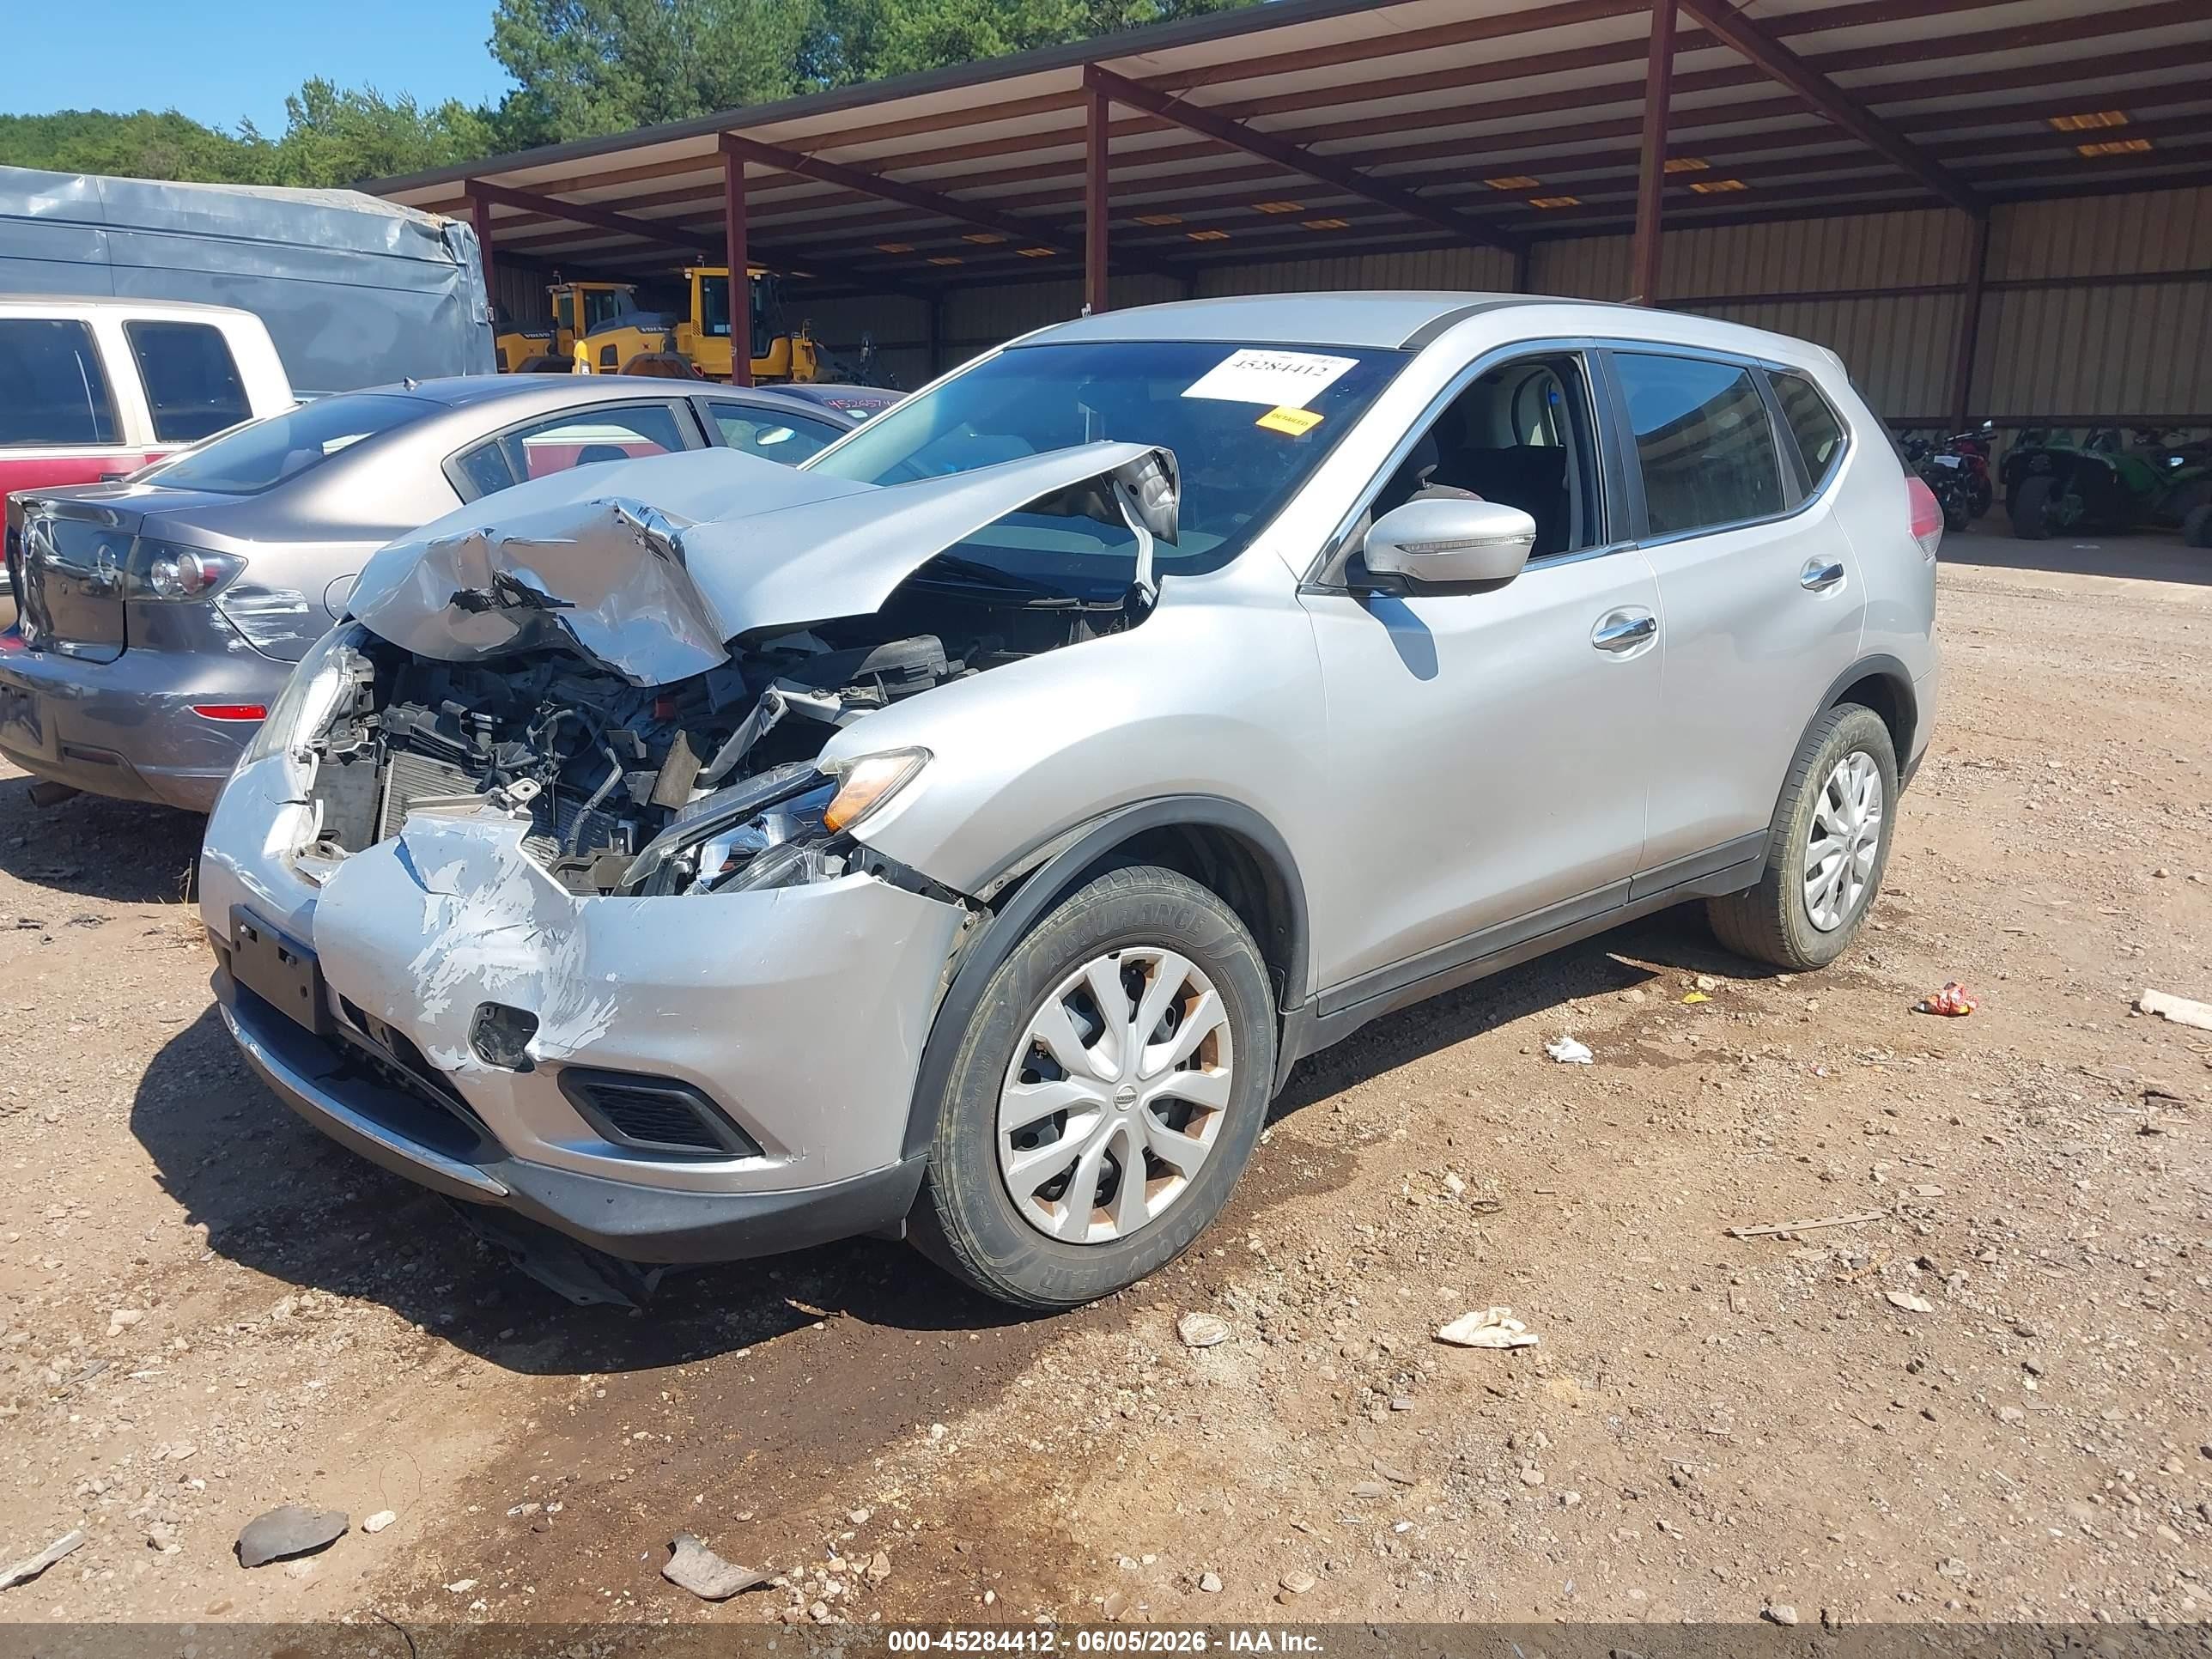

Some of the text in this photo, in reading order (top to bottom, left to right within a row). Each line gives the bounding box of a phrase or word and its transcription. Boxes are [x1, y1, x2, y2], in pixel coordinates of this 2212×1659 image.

[1232, 360, 1328, 377] 45284412
[1270, 412, 1310, 428] DETAILED
[1045, 903, 1206, 971] ASSURANCE
